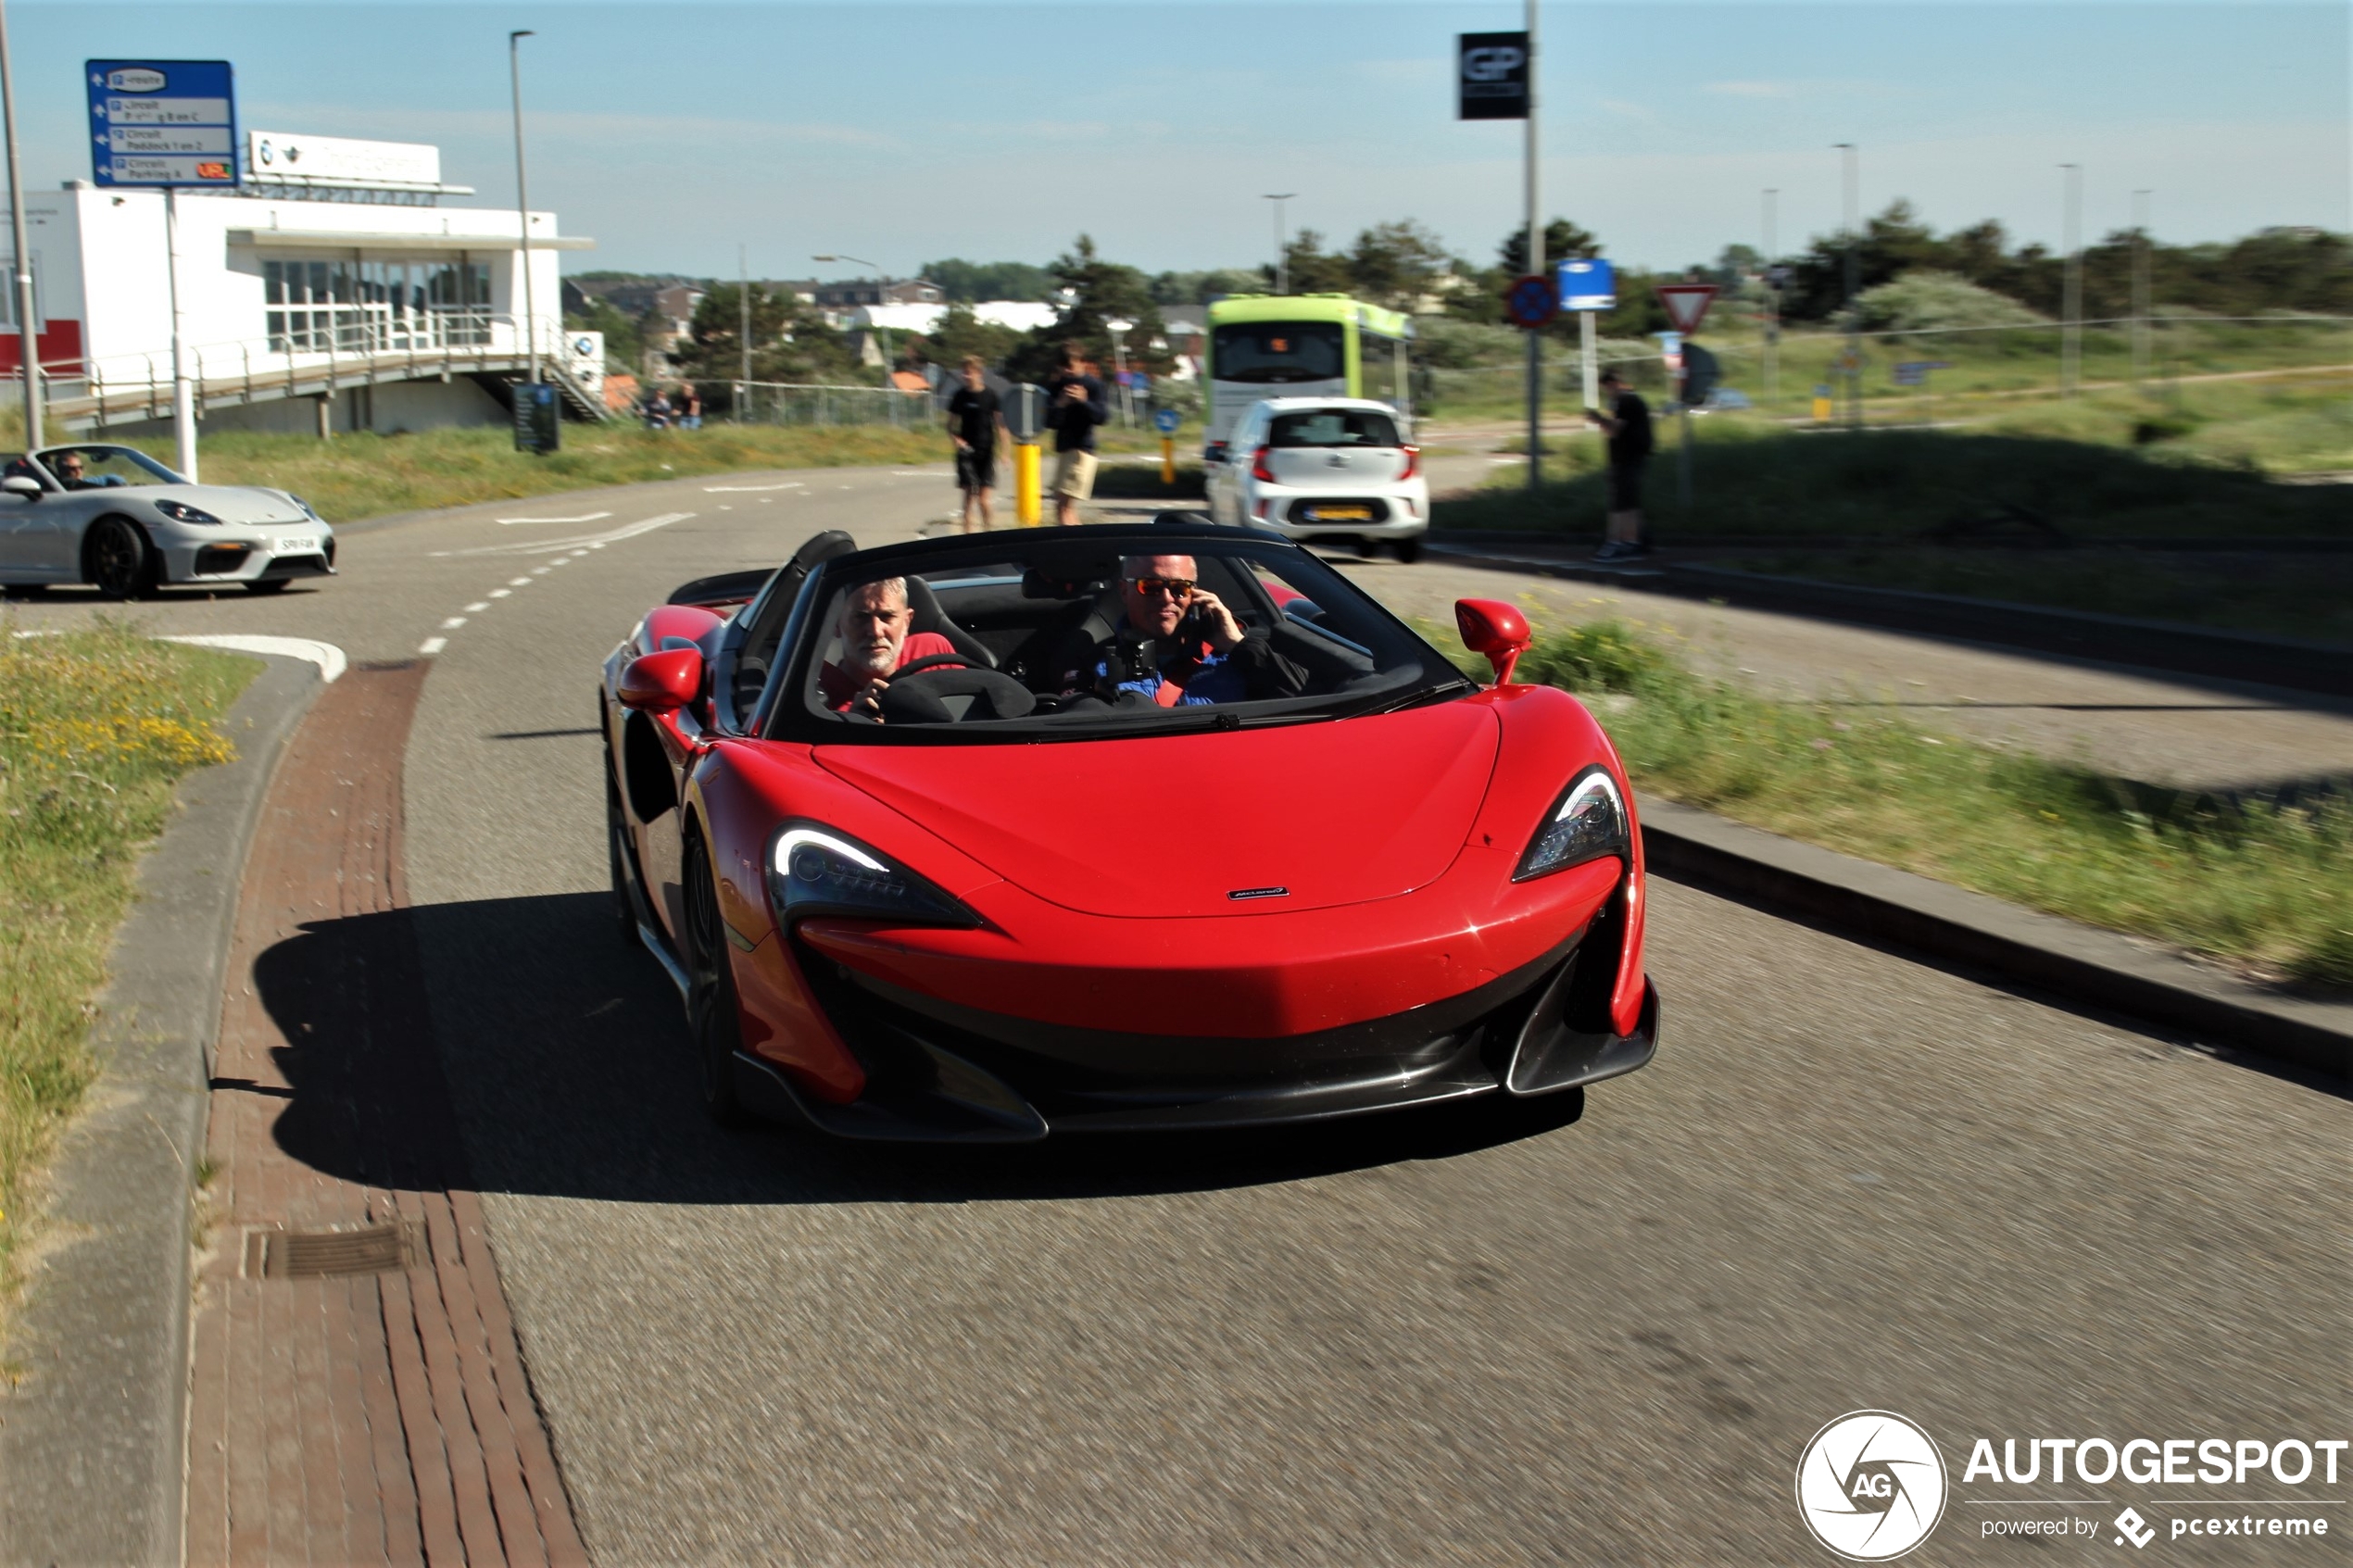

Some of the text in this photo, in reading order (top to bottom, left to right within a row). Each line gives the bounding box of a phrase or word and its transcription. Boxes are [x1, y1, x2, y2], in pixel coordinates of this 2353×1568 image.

[126, 130, 162, 139] Circuit
[129, 159, 166, 169] Circuit
[1235, 888, 1282, 897] McLaren
